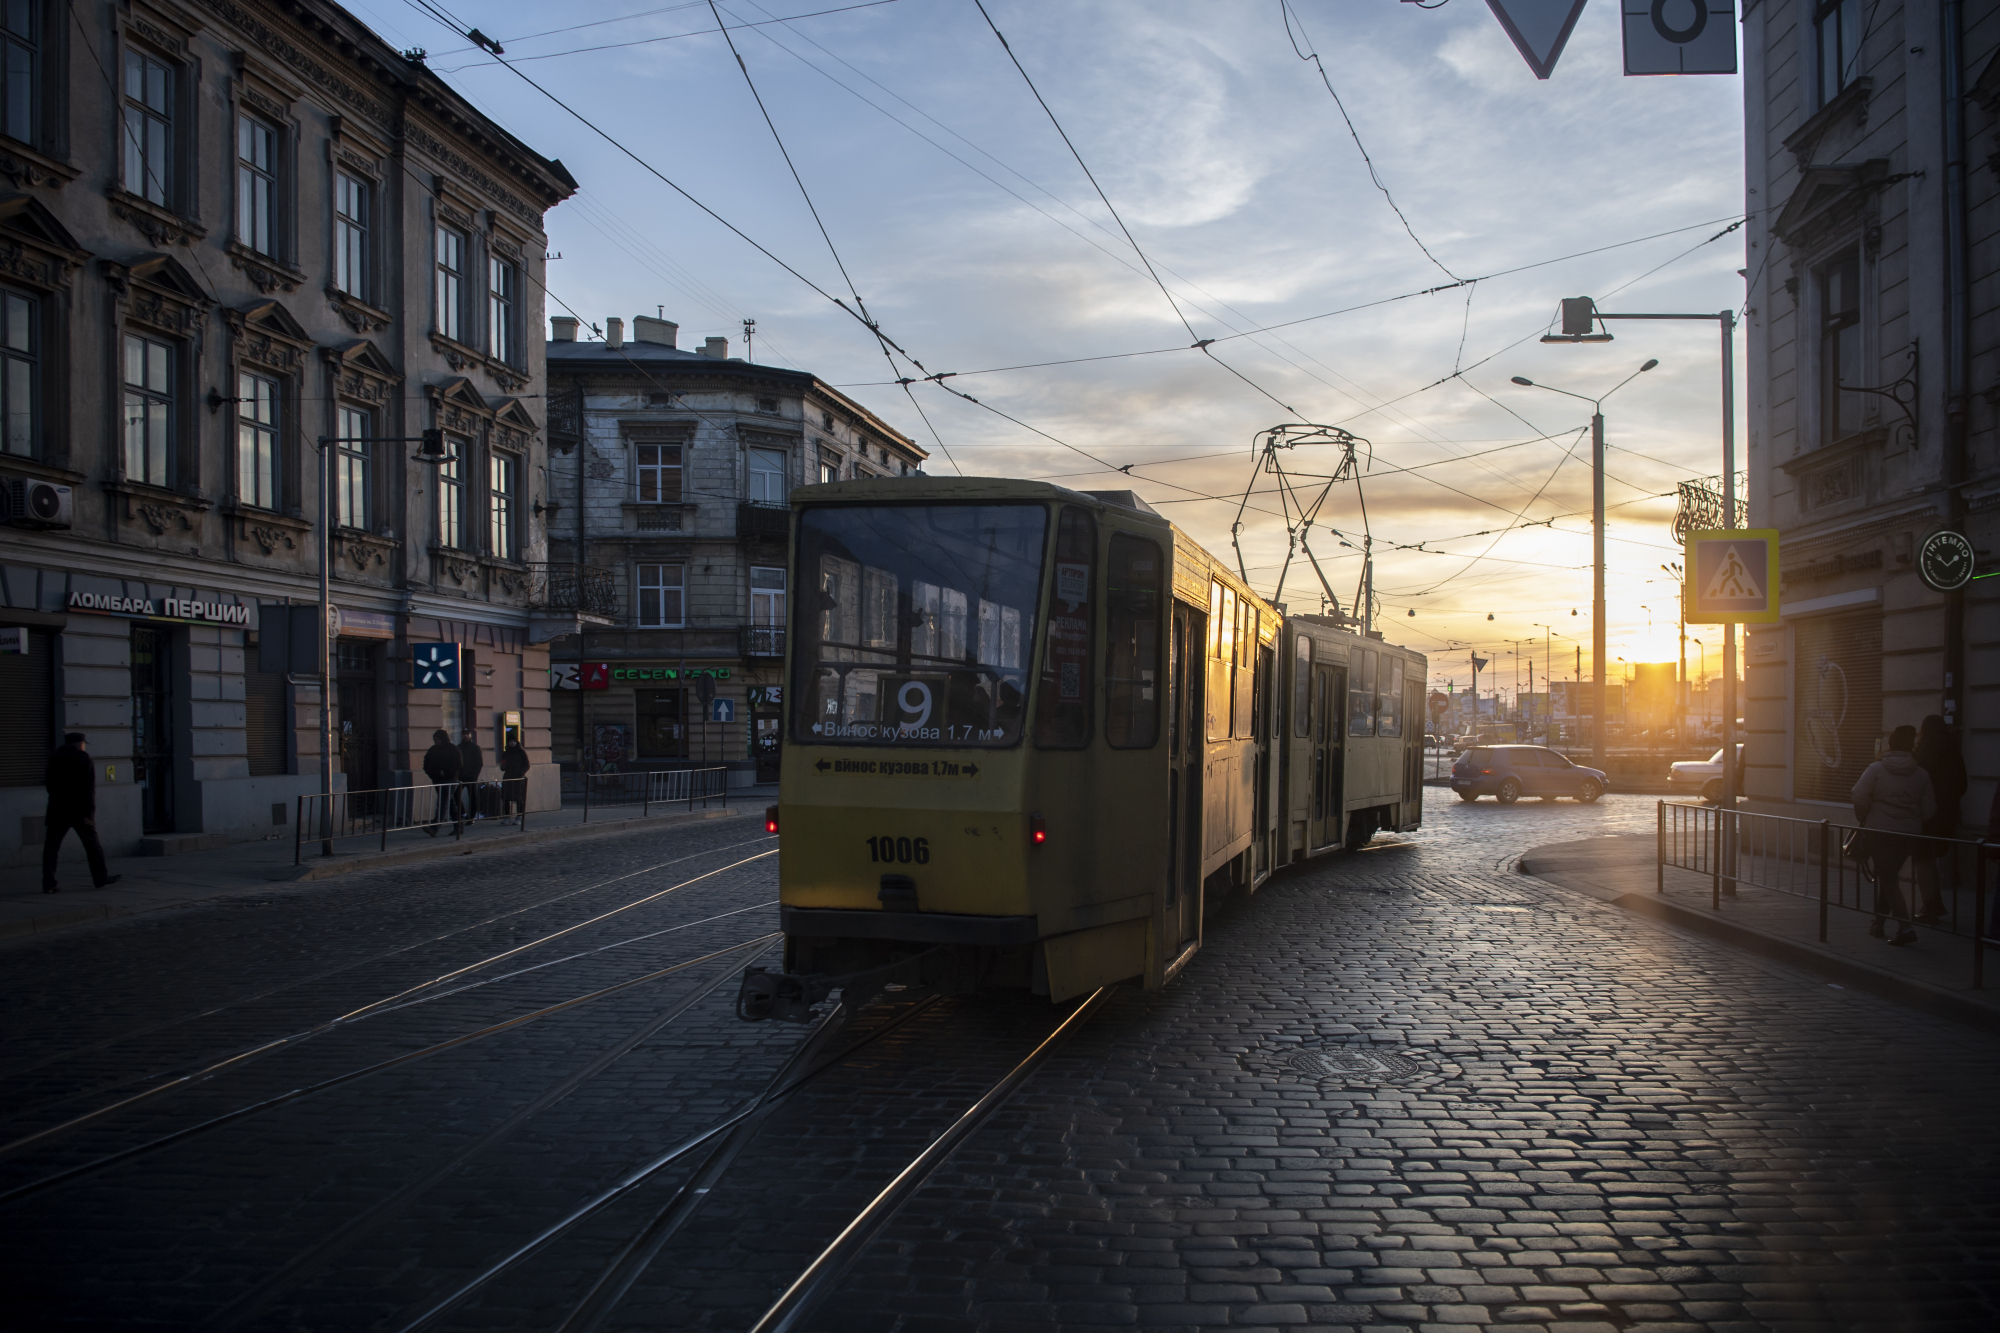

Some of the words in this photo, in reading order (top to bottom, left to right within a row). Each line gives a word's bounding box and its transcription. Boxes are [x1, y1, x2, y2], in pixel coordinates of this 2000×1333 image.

[1926, 536, 1969, 558] ІНТЕМПО
[69, 591, 155, 614] ЛОМБАРД
[163, 598, 250, 624] ПЕРШИЙ
[1056, 616, 1087, 631] РЕКЛАМА
[897, 680, 932, 730] 9
[824, 721, 878, 737] Винос
[883, 726, 940, 742] кузова
[948, 725, 973, 740] 1.7
[978, 729, 991, 740] м
[879, 761, 929, 776] кузова
[932, 761, 959, 777] 1,7м
[866, 836, 930, 865] 1006
